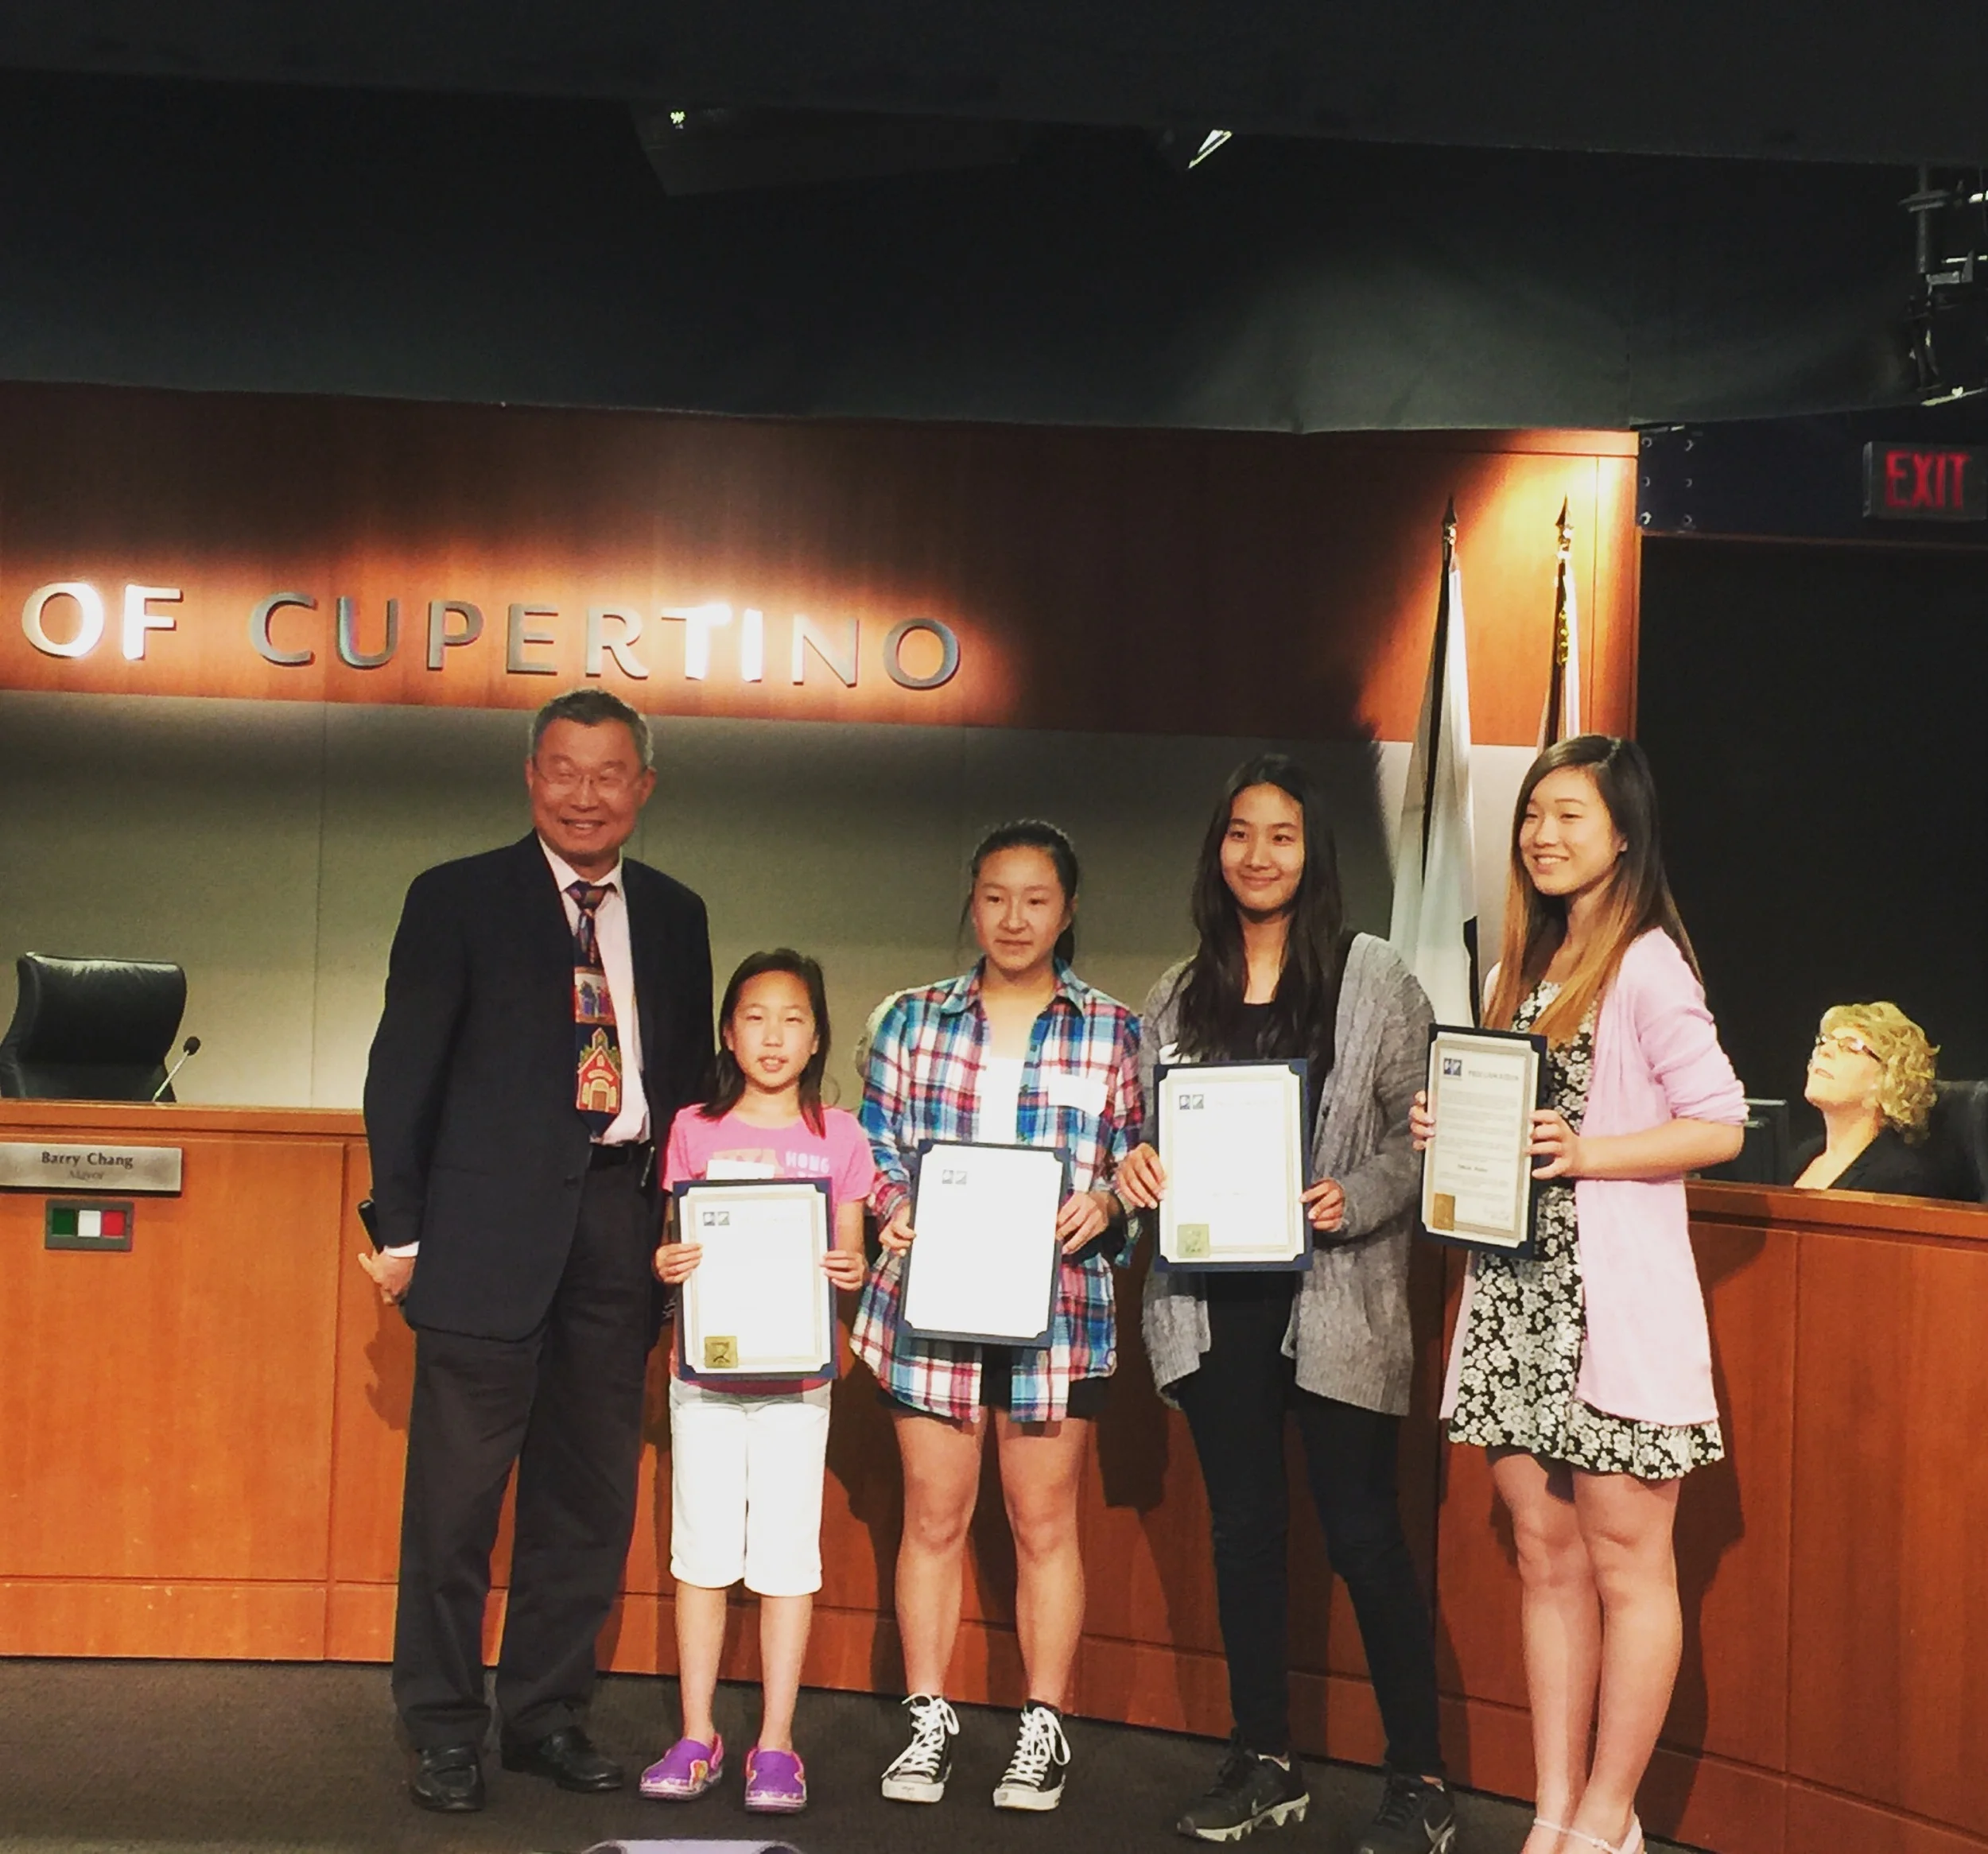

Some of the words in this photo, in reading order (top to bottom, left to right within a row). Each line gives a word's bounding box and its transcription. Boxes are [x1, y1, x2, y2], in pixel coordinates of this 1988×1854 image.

[1885, 451, 1971, 509] EXIT
[22, 581, 184, 662] OF
[250, 591, 961, 690] CUPERTINO
[41, 1151, 80, 1167] Barry
[87, 1152, 134, 1169] Chang
[785, 1150, 830, 1173] HONG
